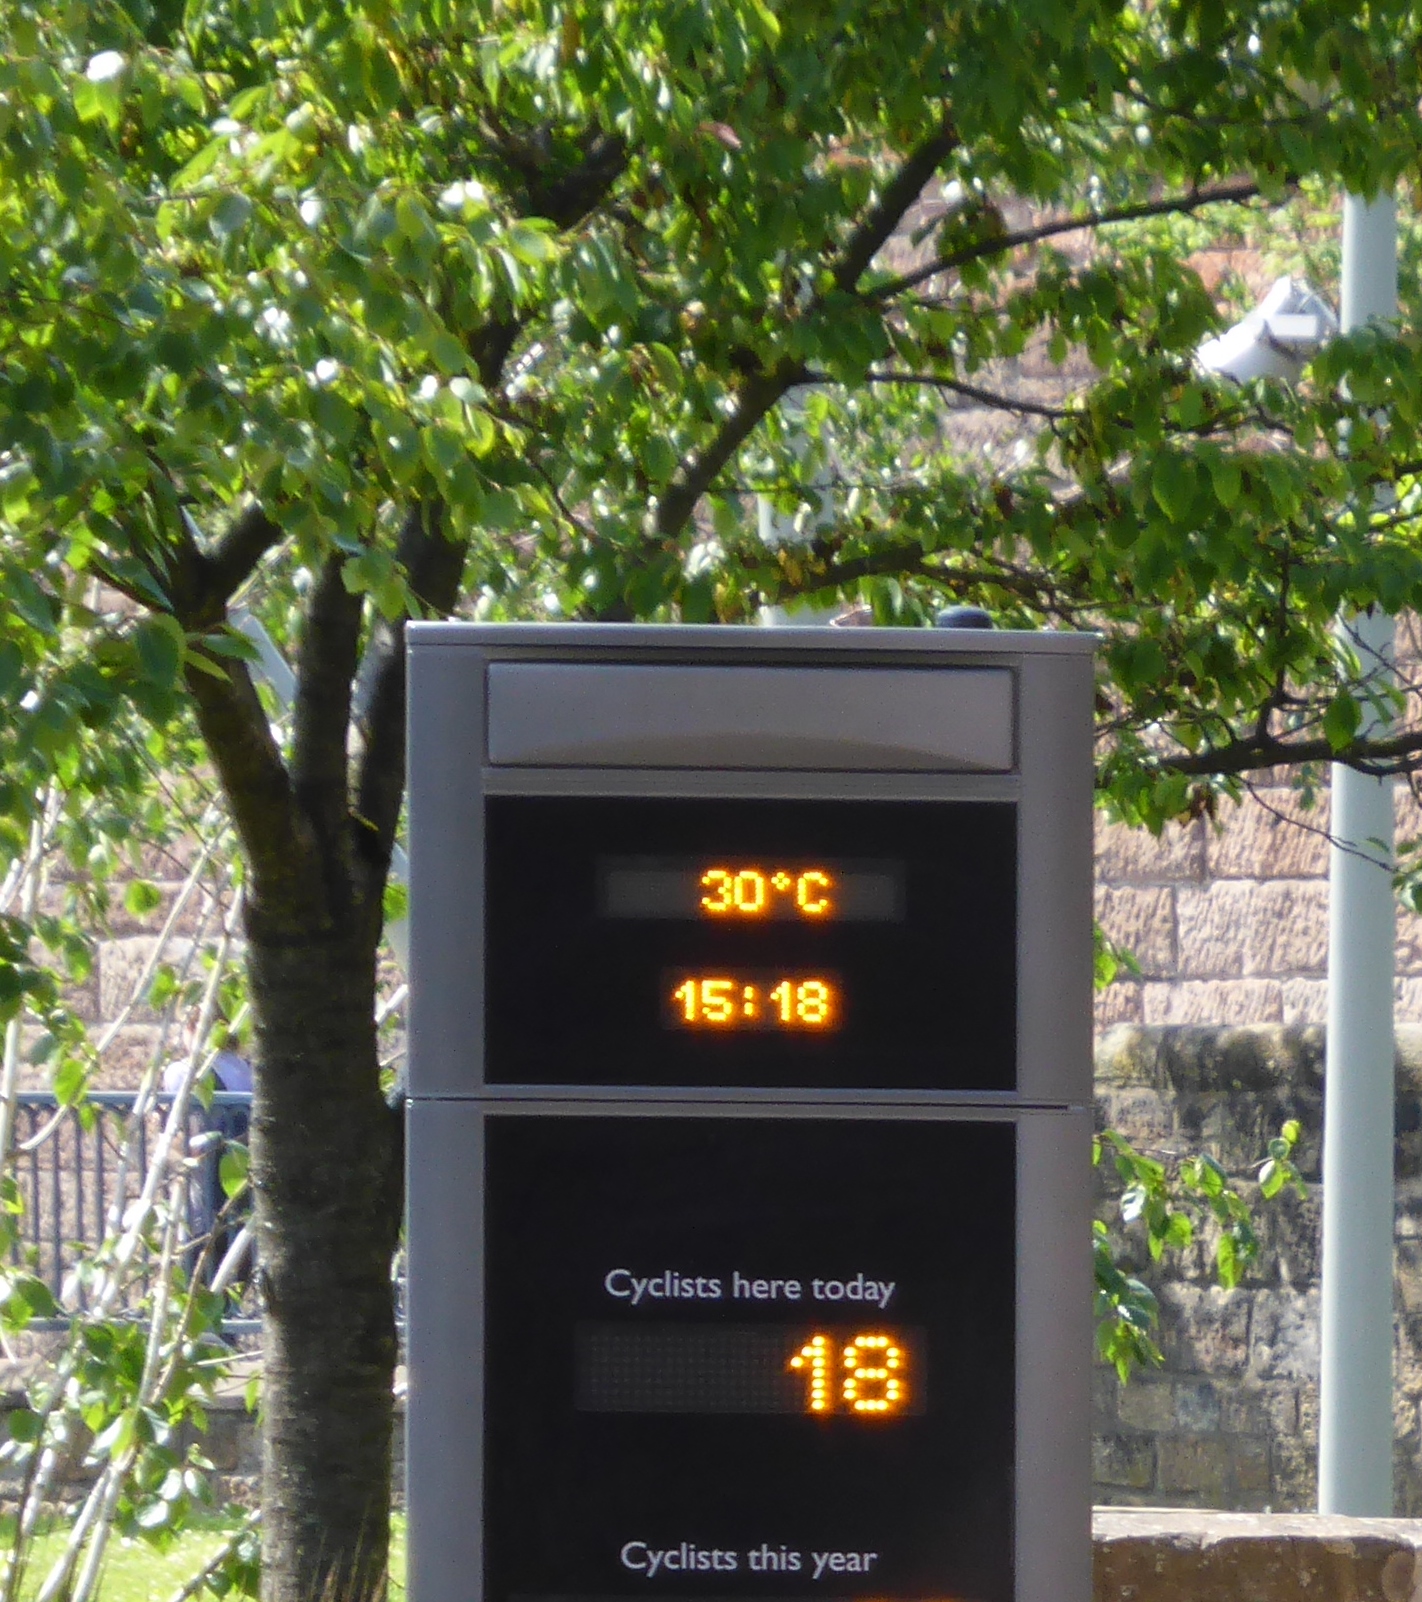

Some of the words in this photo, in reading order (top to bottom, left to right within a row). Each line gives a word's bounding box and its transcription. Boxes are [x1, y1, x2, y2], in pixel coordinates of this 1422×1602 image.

[700, 867, 834, 918] 30°C
[672, 977, 836, 1028] 15:18
[605, 1269, 721, 1304] Cyclists
[734, 1271, 801, 1300] here
[812, 1272, 895, 1309] today
[788, 1332, 907, 1416] 18
[622, 1541, 737, 1577] Cyclists
[748, 1544, 801, 1571] this
[811, 1552, 878, 1579] year
